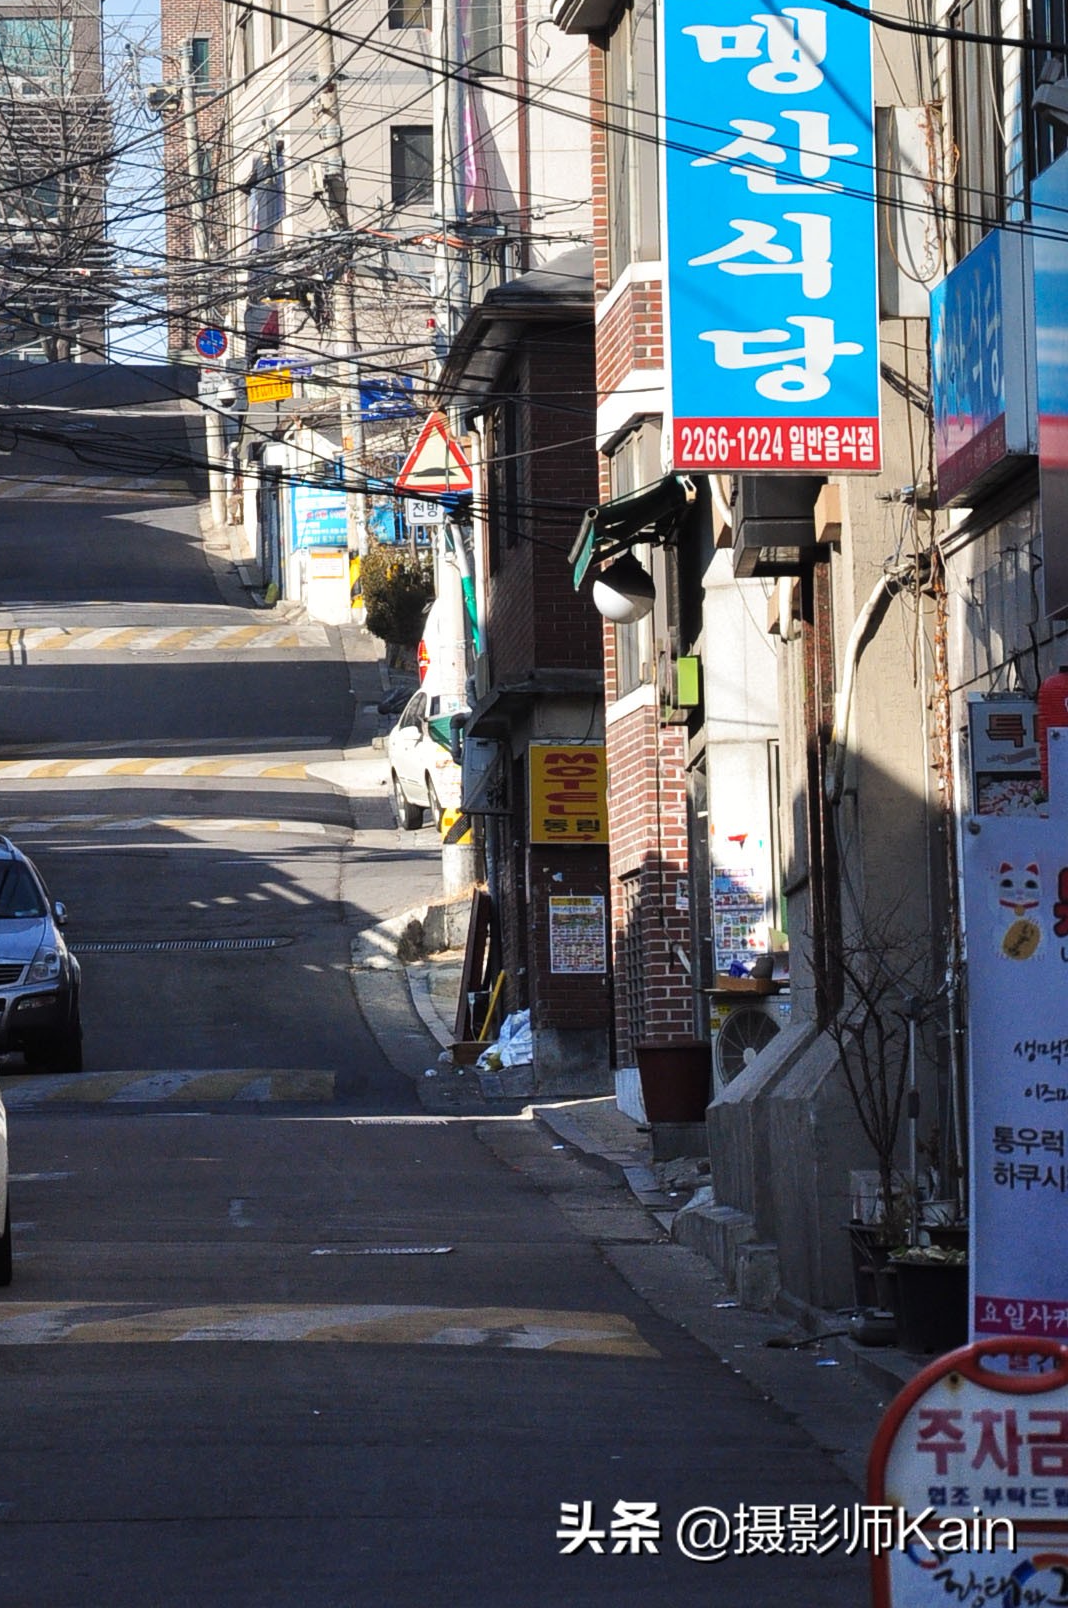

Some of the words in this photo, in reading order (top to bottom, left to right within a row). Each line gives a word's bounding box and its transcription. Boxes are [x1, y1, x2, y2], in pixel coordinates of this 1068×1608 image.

[681, 7, 864, 402] 맹산식당
[681, 425, 784, 462] 2266-1224
[789, 425, 874, 462] 일반음식점
[544, 753, 599, 815] MOTEL
[992, 1126, 1064, 1158] 통우럭
[928, 1486, 970, 1507] 협조
